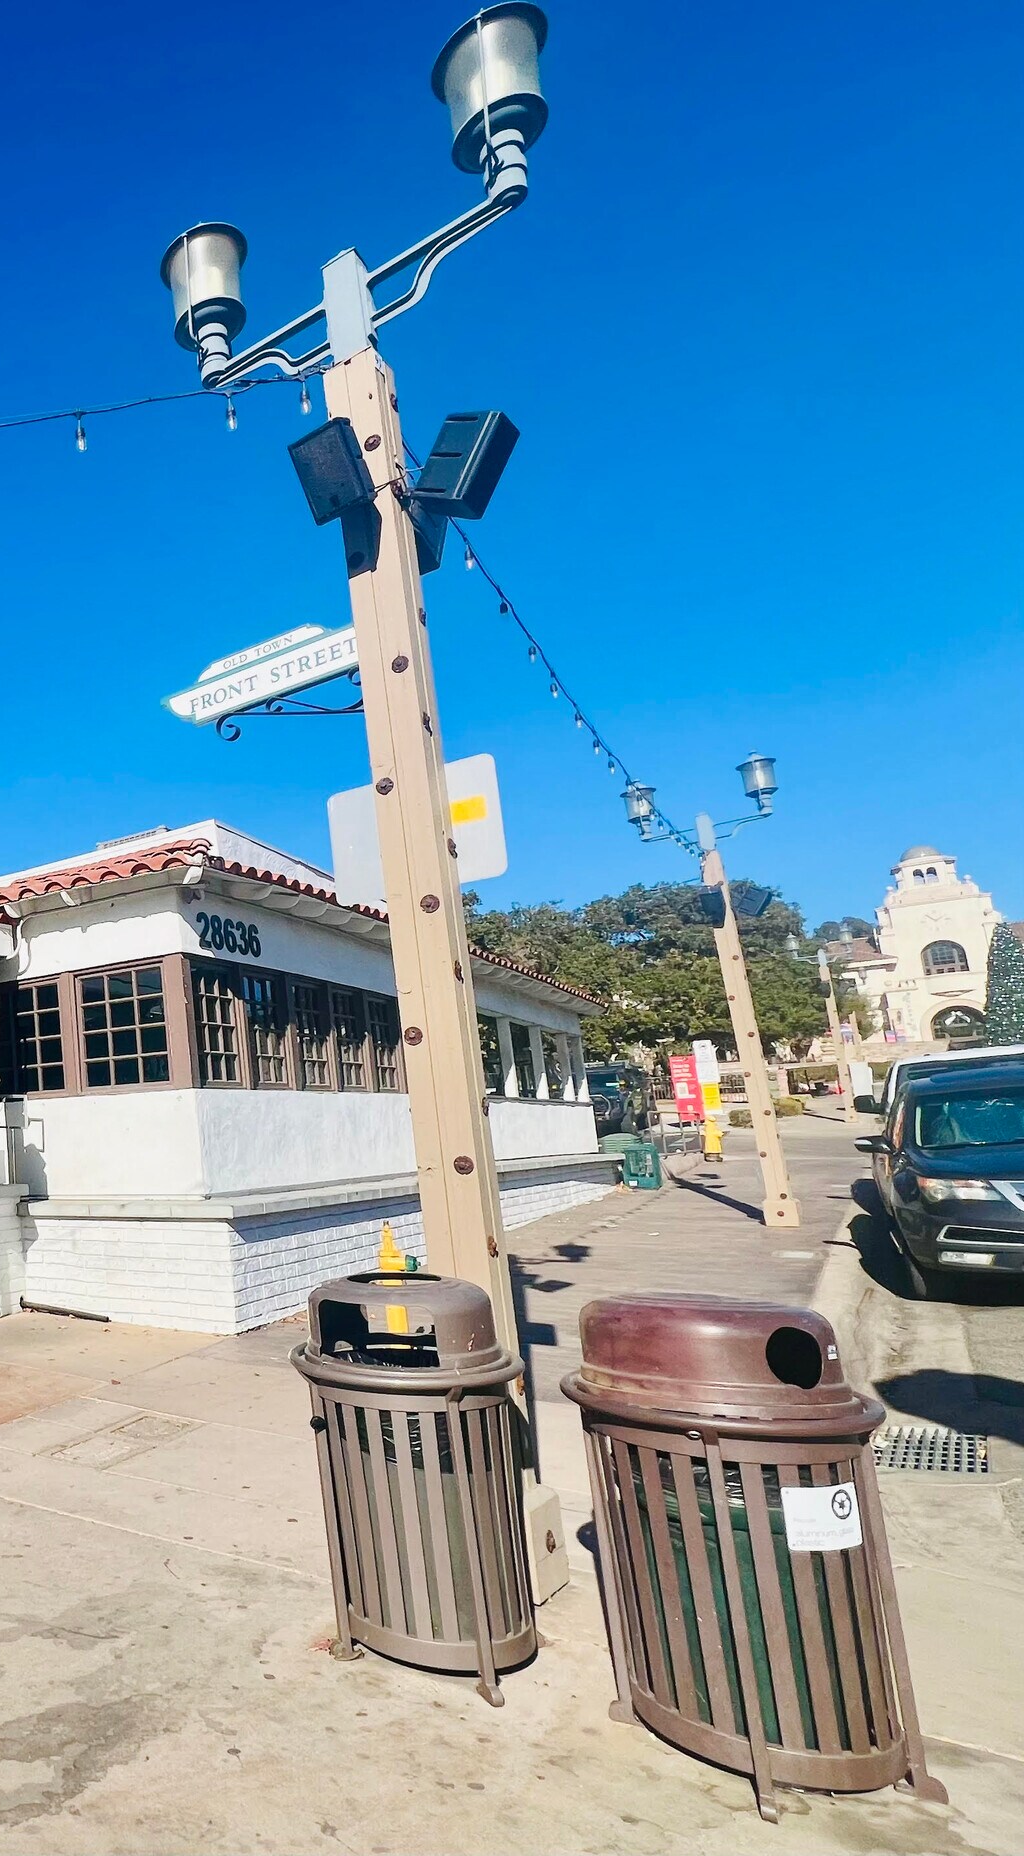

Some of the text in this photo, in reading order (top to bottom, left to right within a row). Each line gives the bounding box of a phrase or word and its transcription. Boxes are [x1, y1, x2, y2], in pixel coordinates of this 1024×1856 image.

[222, 635, 294, 669] OLD TOWN
[189, 637, 358, 715] FRONT STREET
[195, 911, 262, 958] 28636
